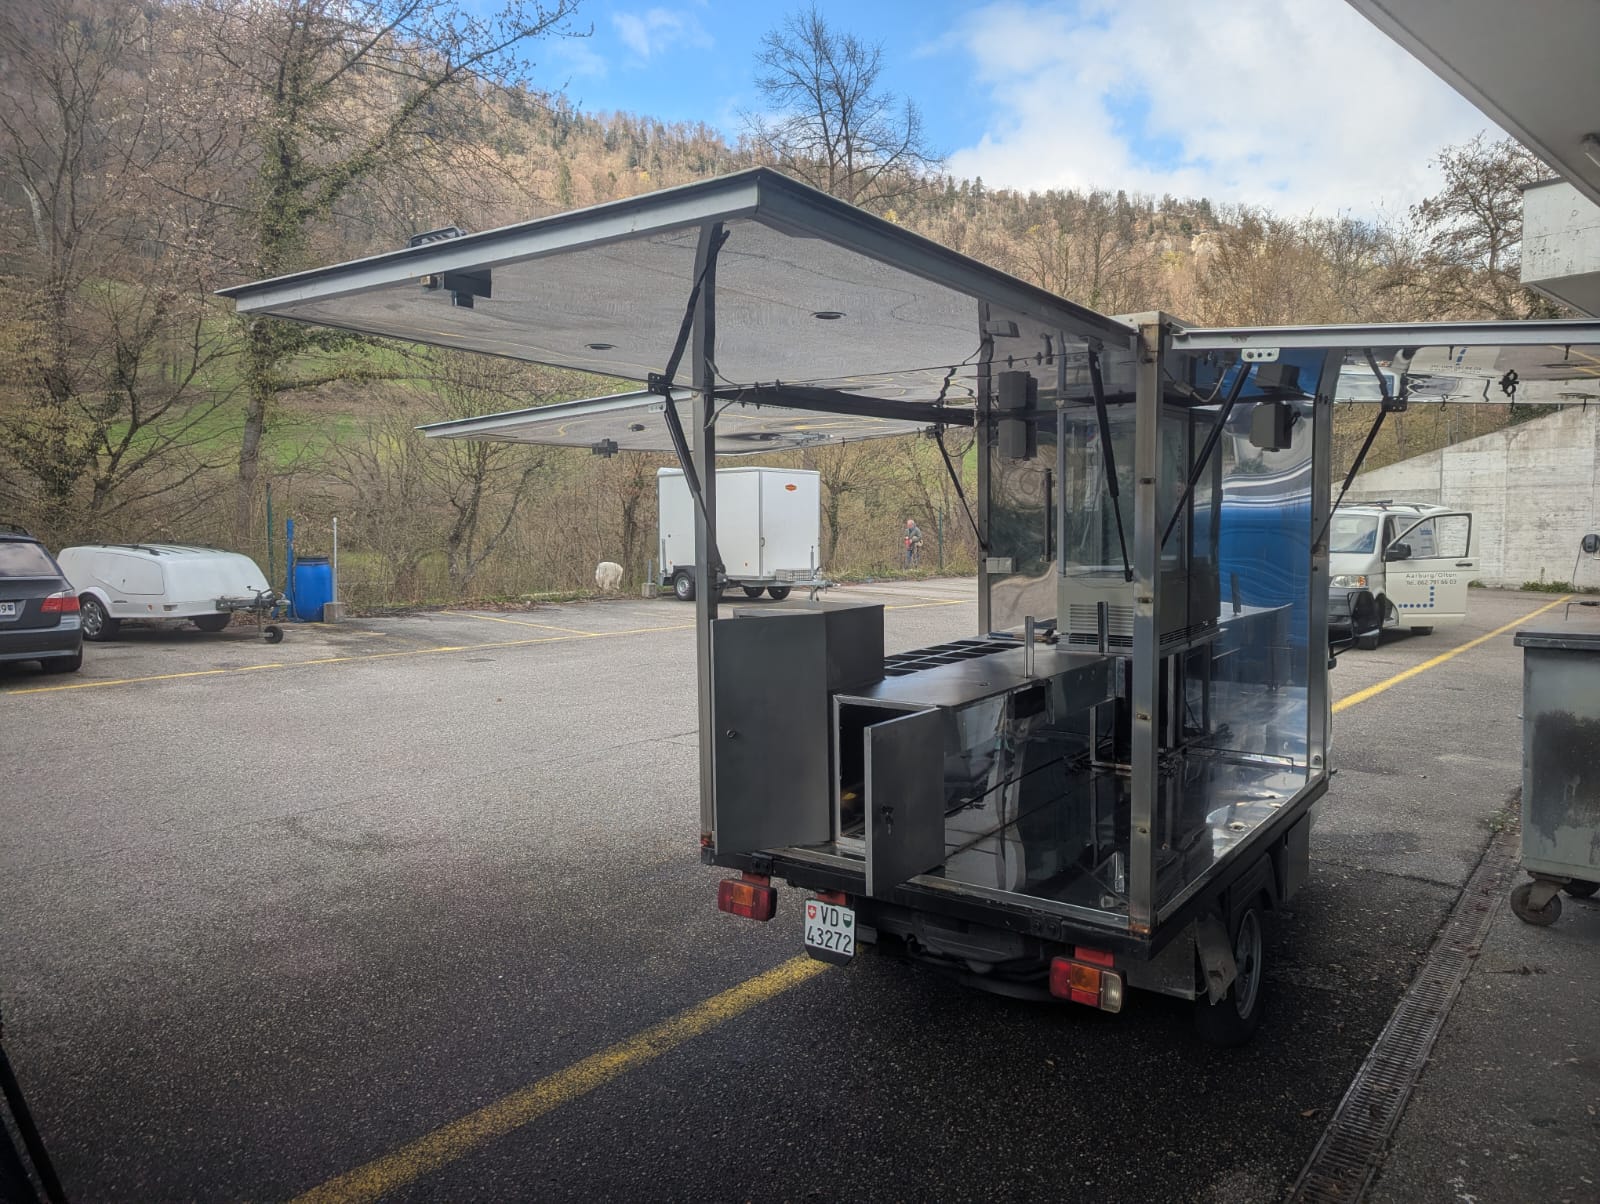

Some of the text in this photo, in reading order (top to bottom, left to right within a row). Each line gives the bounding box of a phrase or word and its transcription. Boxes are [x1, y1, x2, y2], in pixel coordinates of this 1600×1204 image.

[0, 604, 7, 613] 9
[820, 905, 839, 927] VD
[806, 925, 852, 953] 43272
